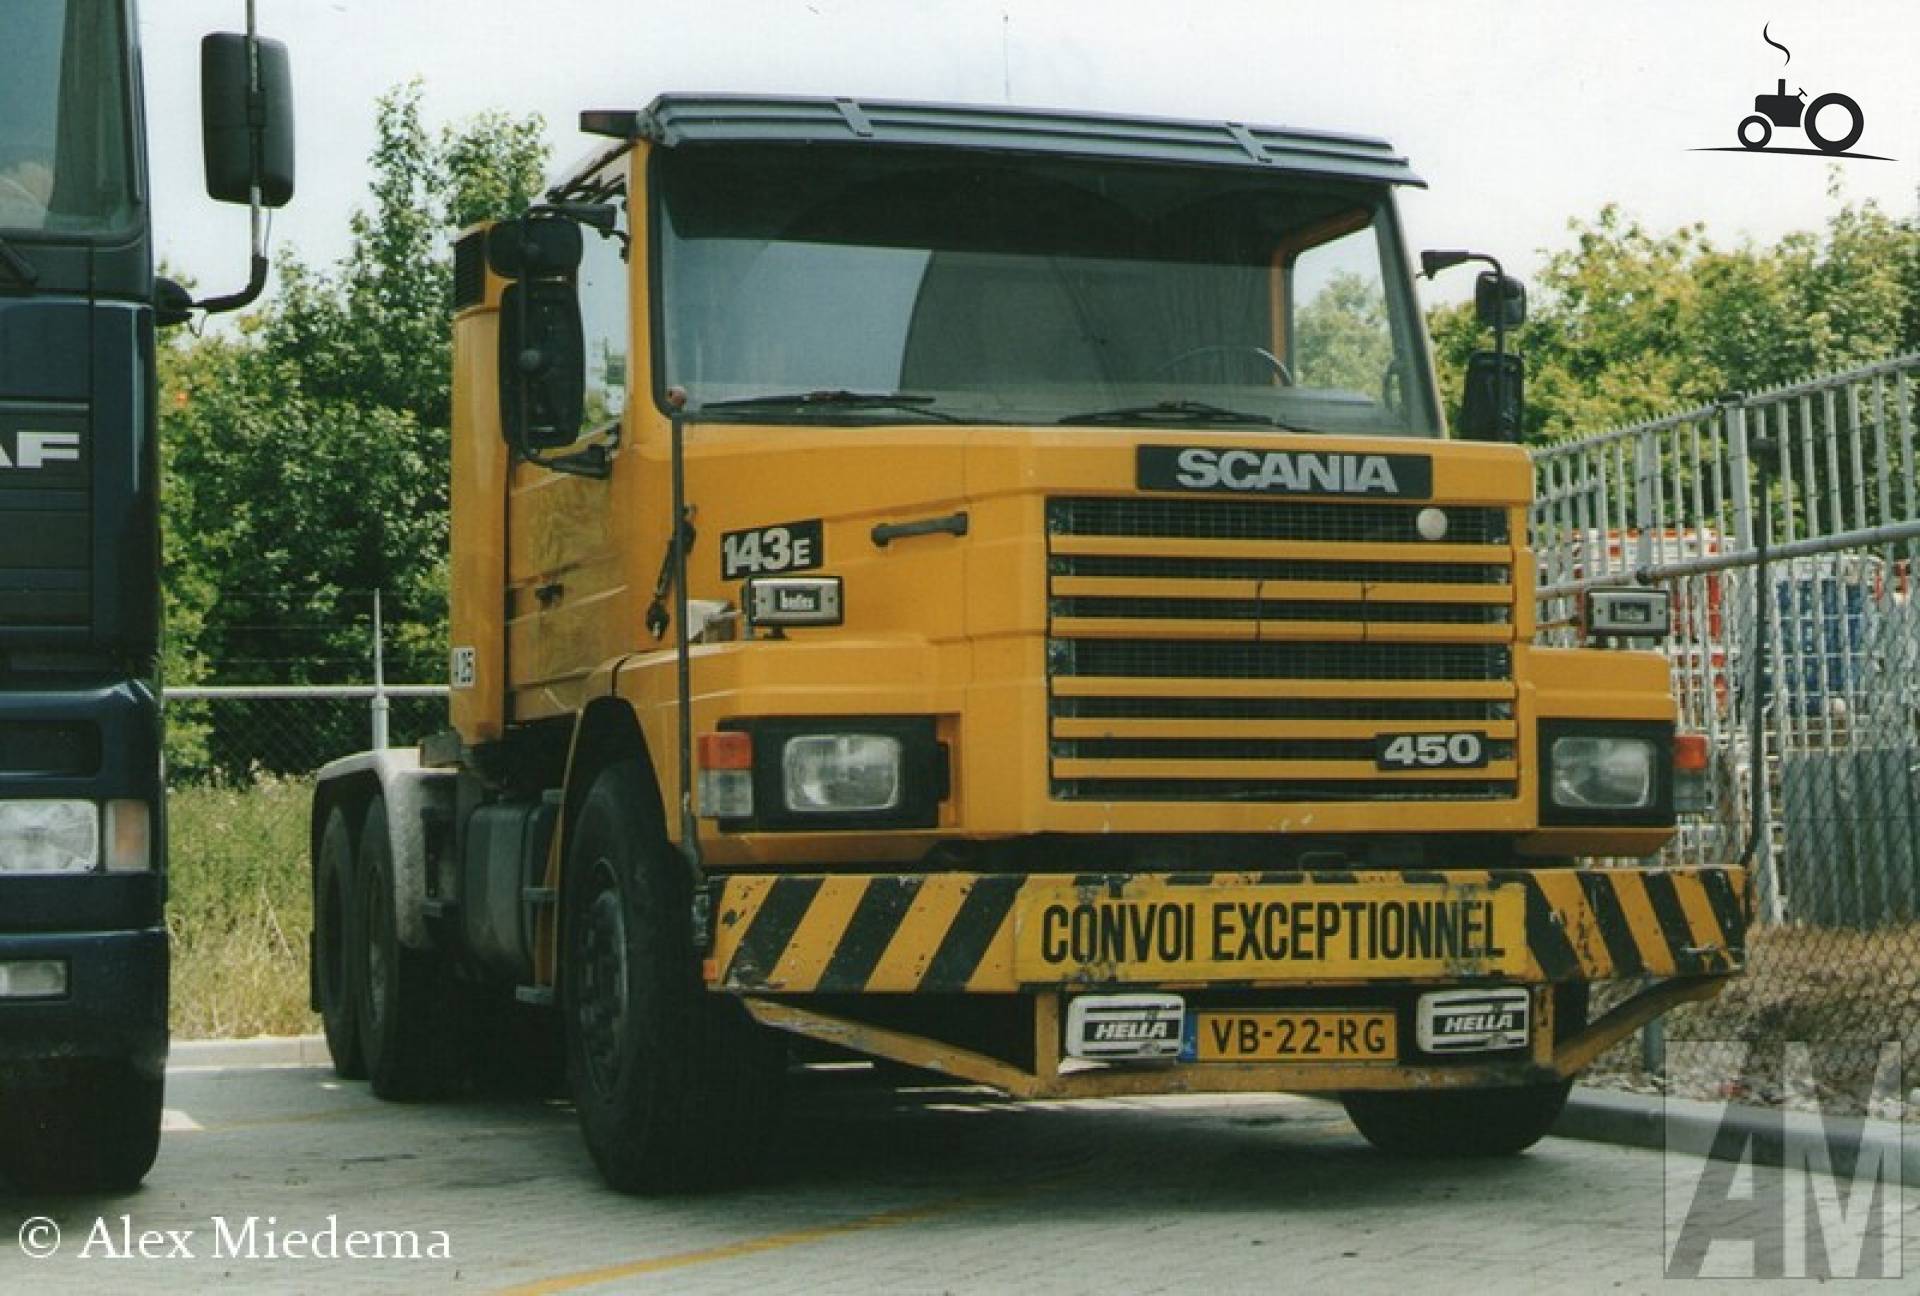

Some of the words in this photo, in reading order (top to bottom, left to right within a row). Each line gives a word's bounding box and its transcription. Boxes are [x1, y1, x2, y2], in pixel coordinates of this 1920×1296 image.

[0, 431, 80, 468] F
[1176, 448, 1400, 493] SCANIA
[1384, 734, 1482, 765] 450
[1042, 902, 1194, 964] CONVOI
[1212, 901, 1506, 960] EXCEPTIONNEL
[1095, 1021, 1168, 1041] HELLA
[1211, 1018, 1387, 1055] VB-22-RG
[1444, 1012, 1513, 1033] HELLA
